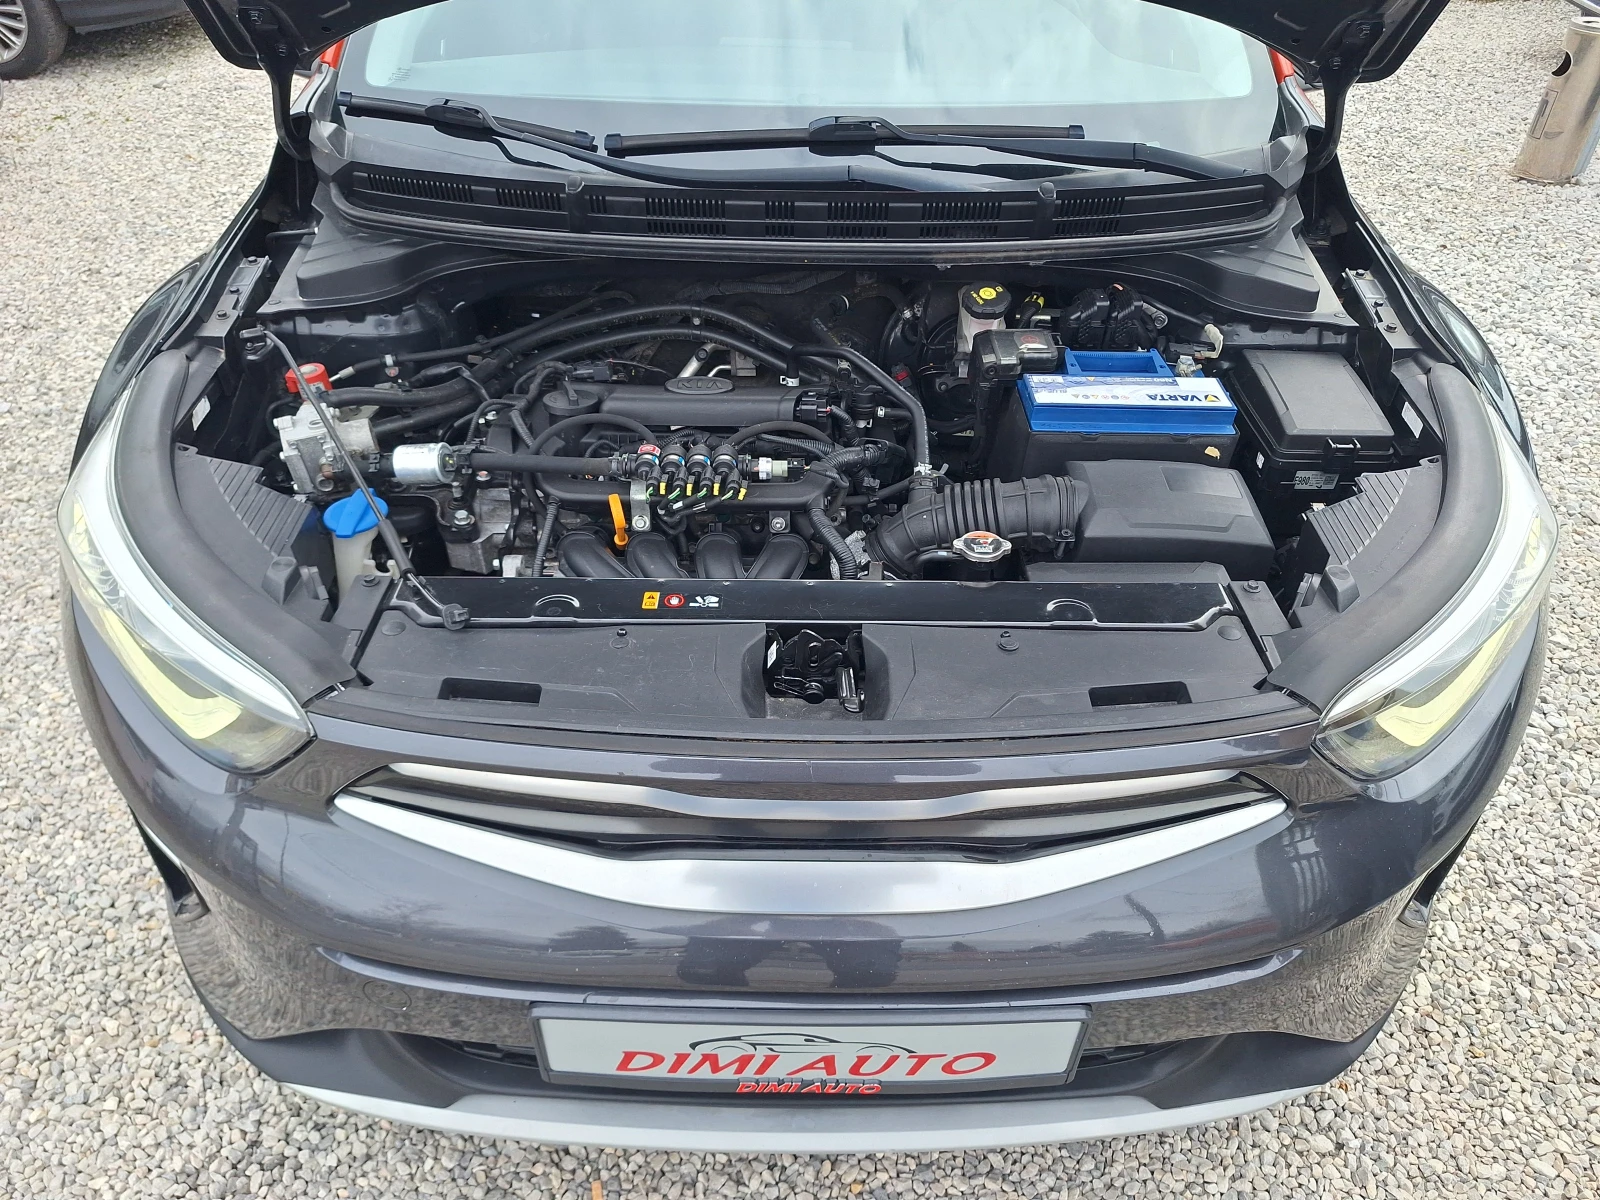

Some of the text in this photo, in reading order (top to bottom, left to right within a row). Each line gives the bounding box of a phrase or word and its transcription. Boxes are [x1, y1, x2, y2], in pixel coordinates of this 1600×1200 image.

[676, 379, 724, 389] KIA
[1145, 393, 1203, 402] VARTA
[615, 1050, 997, 1077] DIMI AUTO
[736, 1081, 883, 1095] DIMI AUTO
